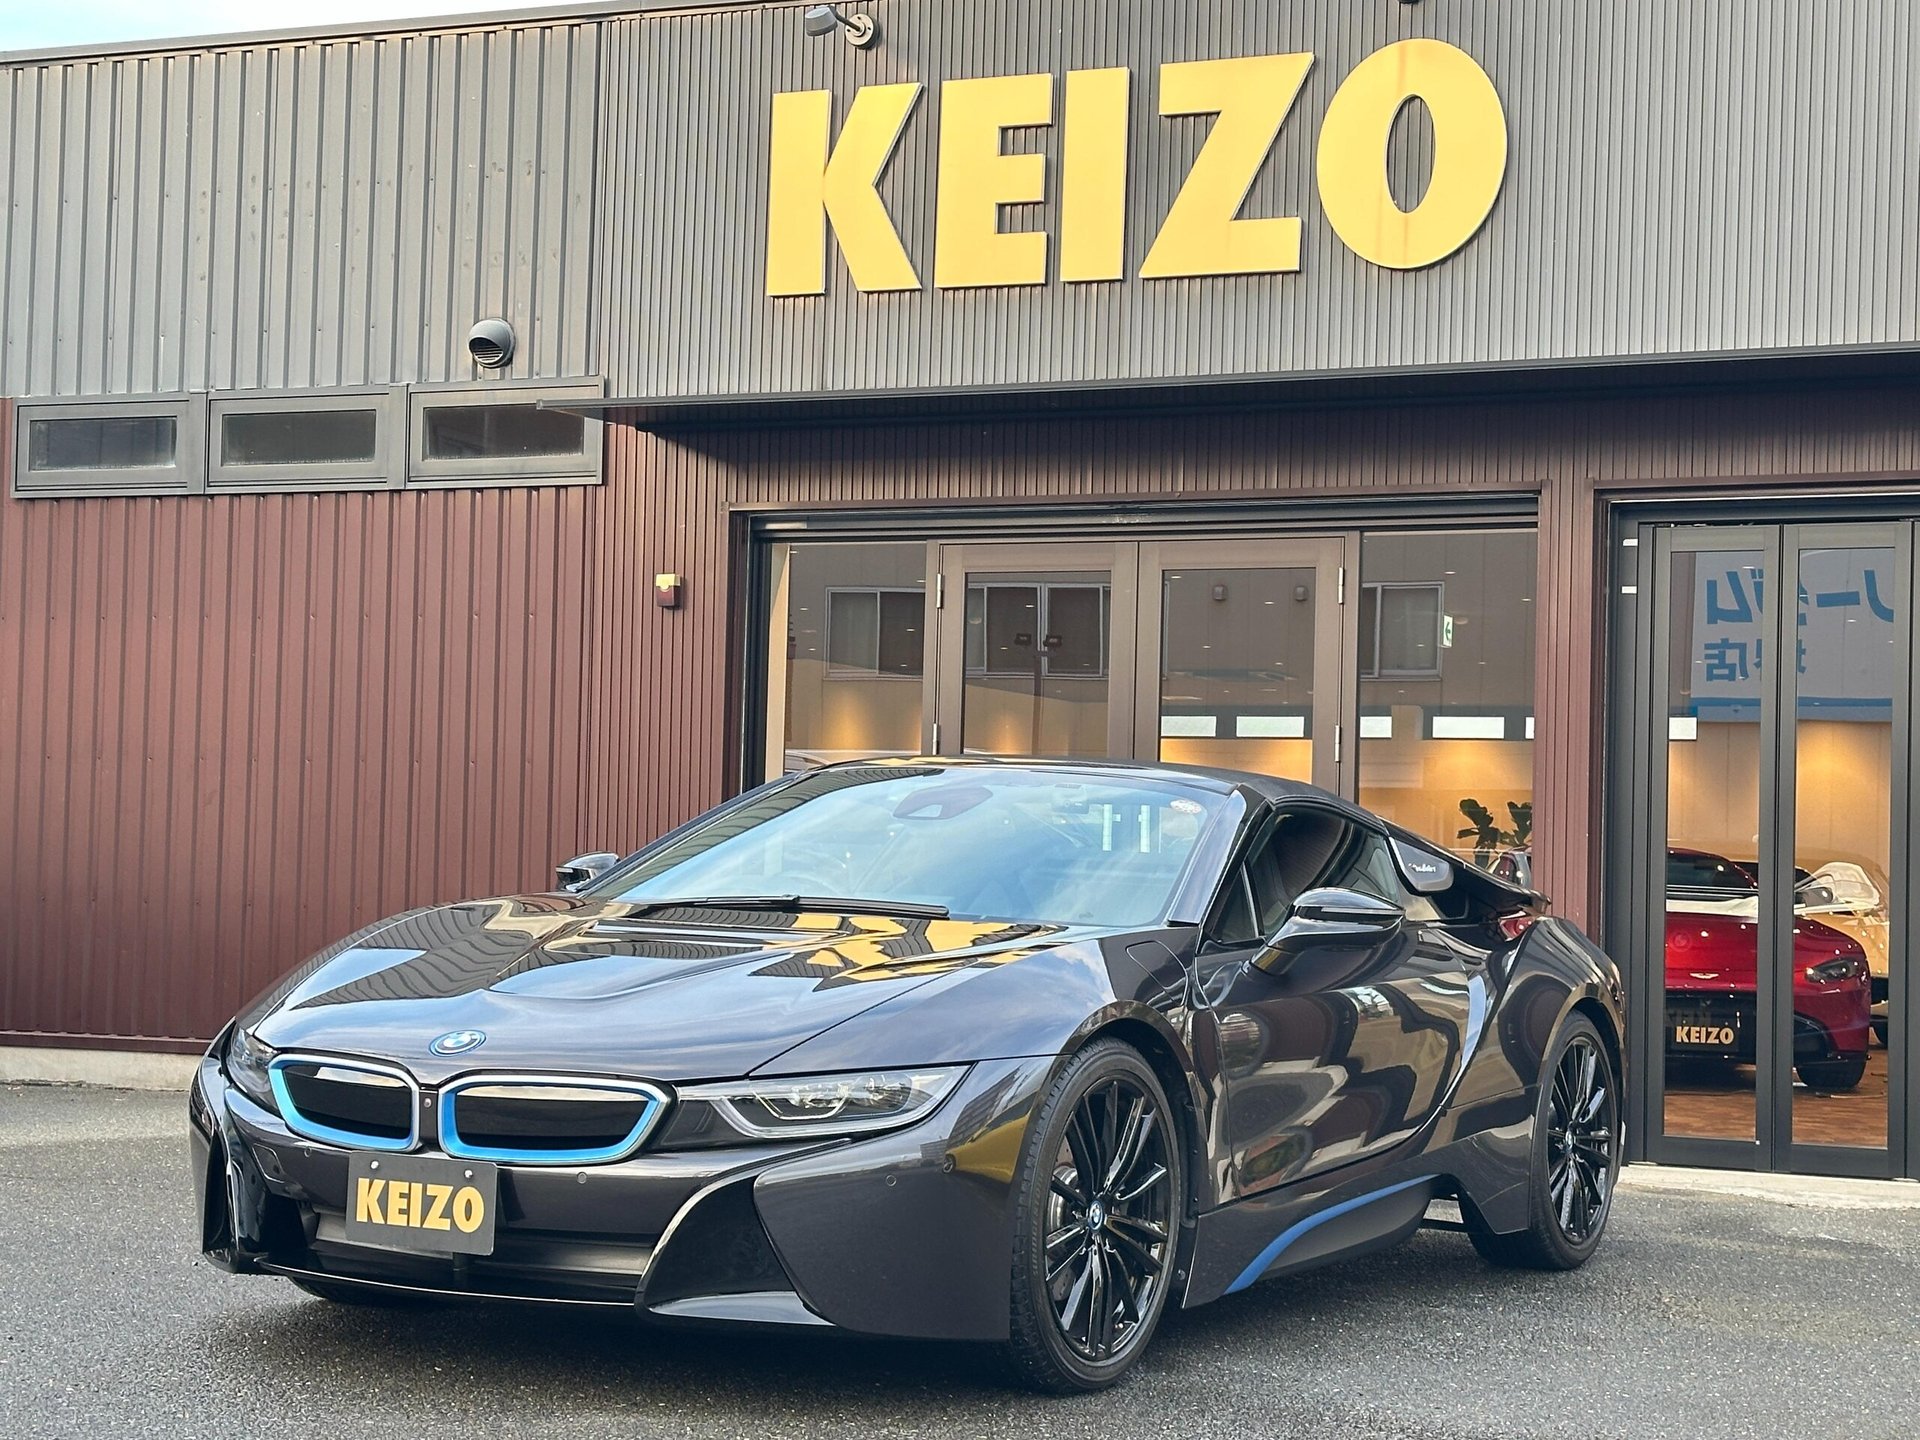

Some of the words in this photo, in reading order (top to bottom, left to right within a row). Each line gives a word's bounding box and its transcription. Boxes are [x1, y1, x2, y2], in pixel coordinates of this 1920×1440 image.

[767, 38, 1508, 297] KEIZO
[1675, 1026, 1734, 1045] KEIZO
[356, 1177, 485, 1233] KEIZO
